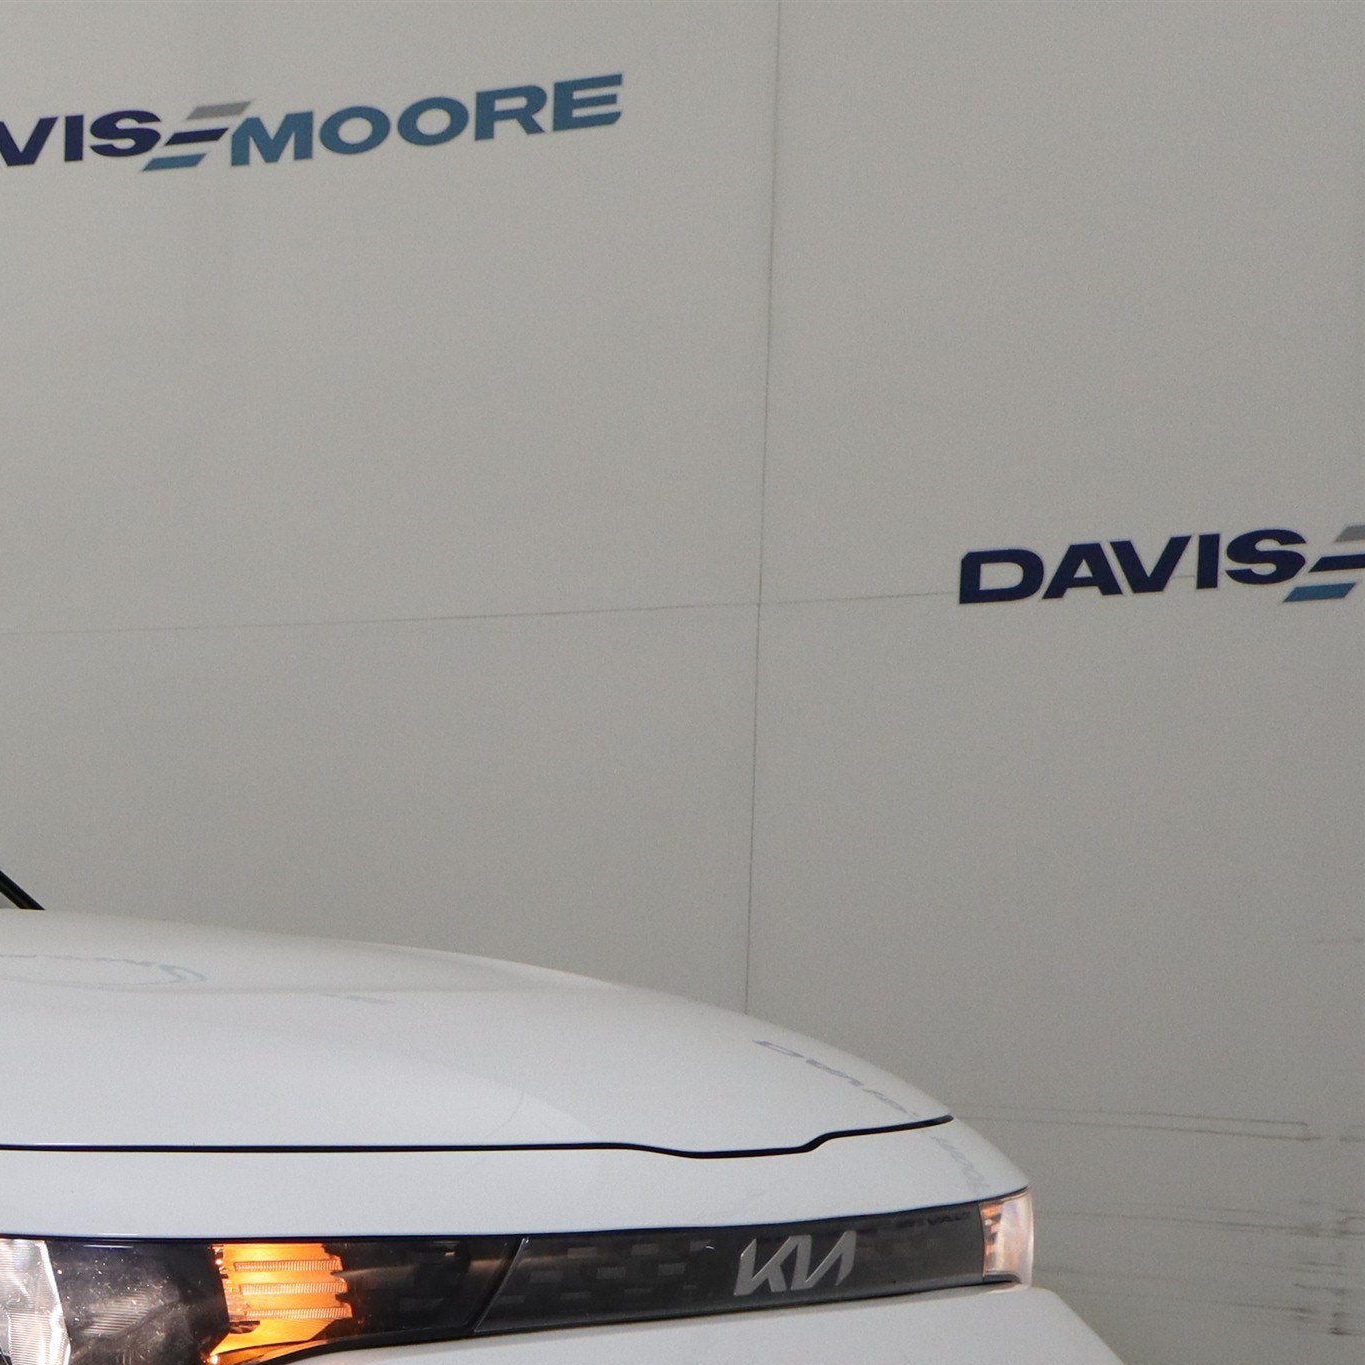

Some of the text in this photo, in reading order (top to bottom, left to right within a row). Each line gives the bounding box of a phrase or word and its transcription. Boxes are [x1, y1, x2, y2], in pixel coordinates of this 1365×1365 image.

[231, 74, 624, 167] MOORE
[959, 528, 1307, 604] DAVIS
[734, 1231, 857, 1297] KIA
